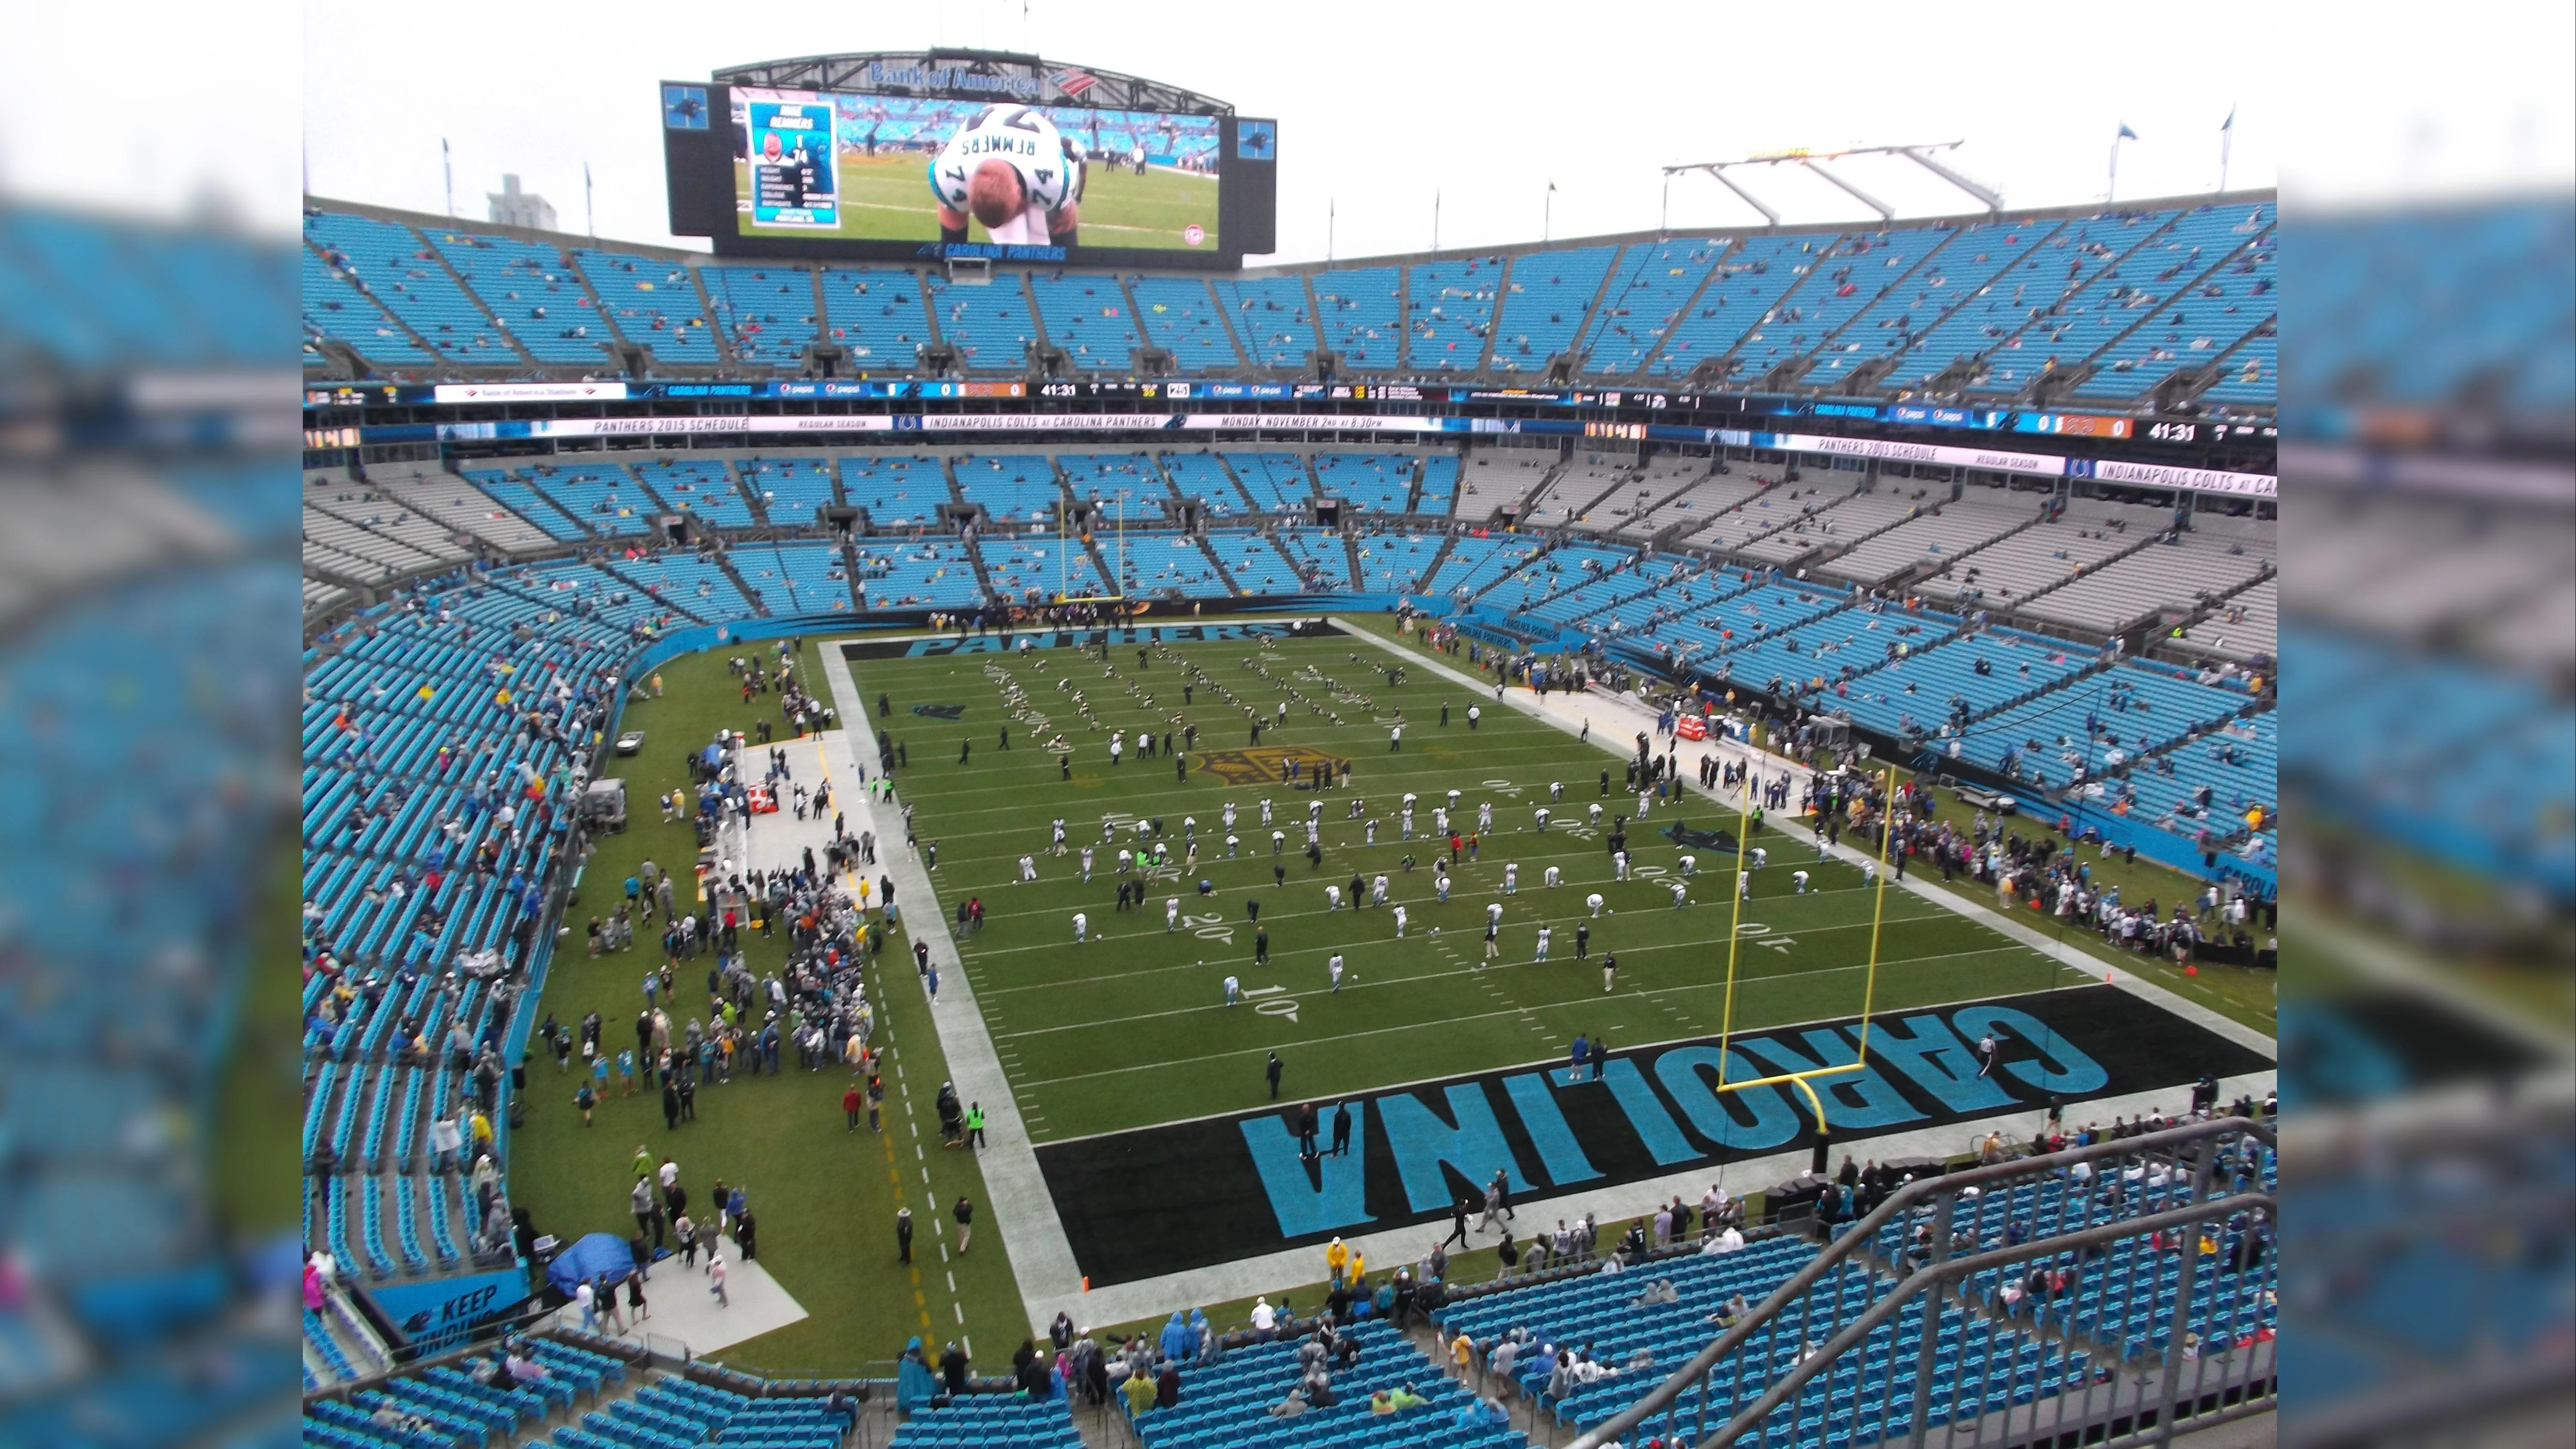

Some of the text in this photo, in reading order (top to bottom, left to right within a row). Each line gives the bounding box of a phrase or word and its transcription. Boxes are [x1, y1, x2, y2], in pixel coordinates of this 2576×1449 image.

[870, 60, 1040, 95] Bank of America
[962, 135, 1035, 156] REMMERS
[1032, 168, 1054, 205] 74
[945, 242, 1067, 261] CAROLINA PANTHERS
[941, 384, 951, 395] 0
[1010, 384, 1020, 396] 0
[1041, 384, 1076, 396] 41:31
[594, 417, 749, 433] PANTHERS 2015 SCHEDULE
[929, 416, 1003, 428] INDIANAPOLIS
[1006, 416, 1037, 428] COLTS
[1053, 415, 1103, 427] CAROLINA
[1106, 415, 1157, 427] PANTHERS
[1266, 416, 1319, 428] NOVEMBER
[2037, 415, 2050, 431] 0
[2112, 420, 2124, 436] 0
[2149, 422, 2196, 441] 41:31
[1818, 438, 1864, 454] PANTHERS
[1891, 443, 1938, 461] SCHEDULE
[1976, 454, 2009, 466] REGULAR
[2102, 462, 2188, 485] INDIANAPOLIS
[2193, 472, 2235, 490] COLTS
[905, 622, 1291, 657] PANTHERS
[1240, 984, 1300, 1016] 10
[1239, 1005, 2109, 1237] CAROLINA
[442, 1284, 497, 1323] KEEP
